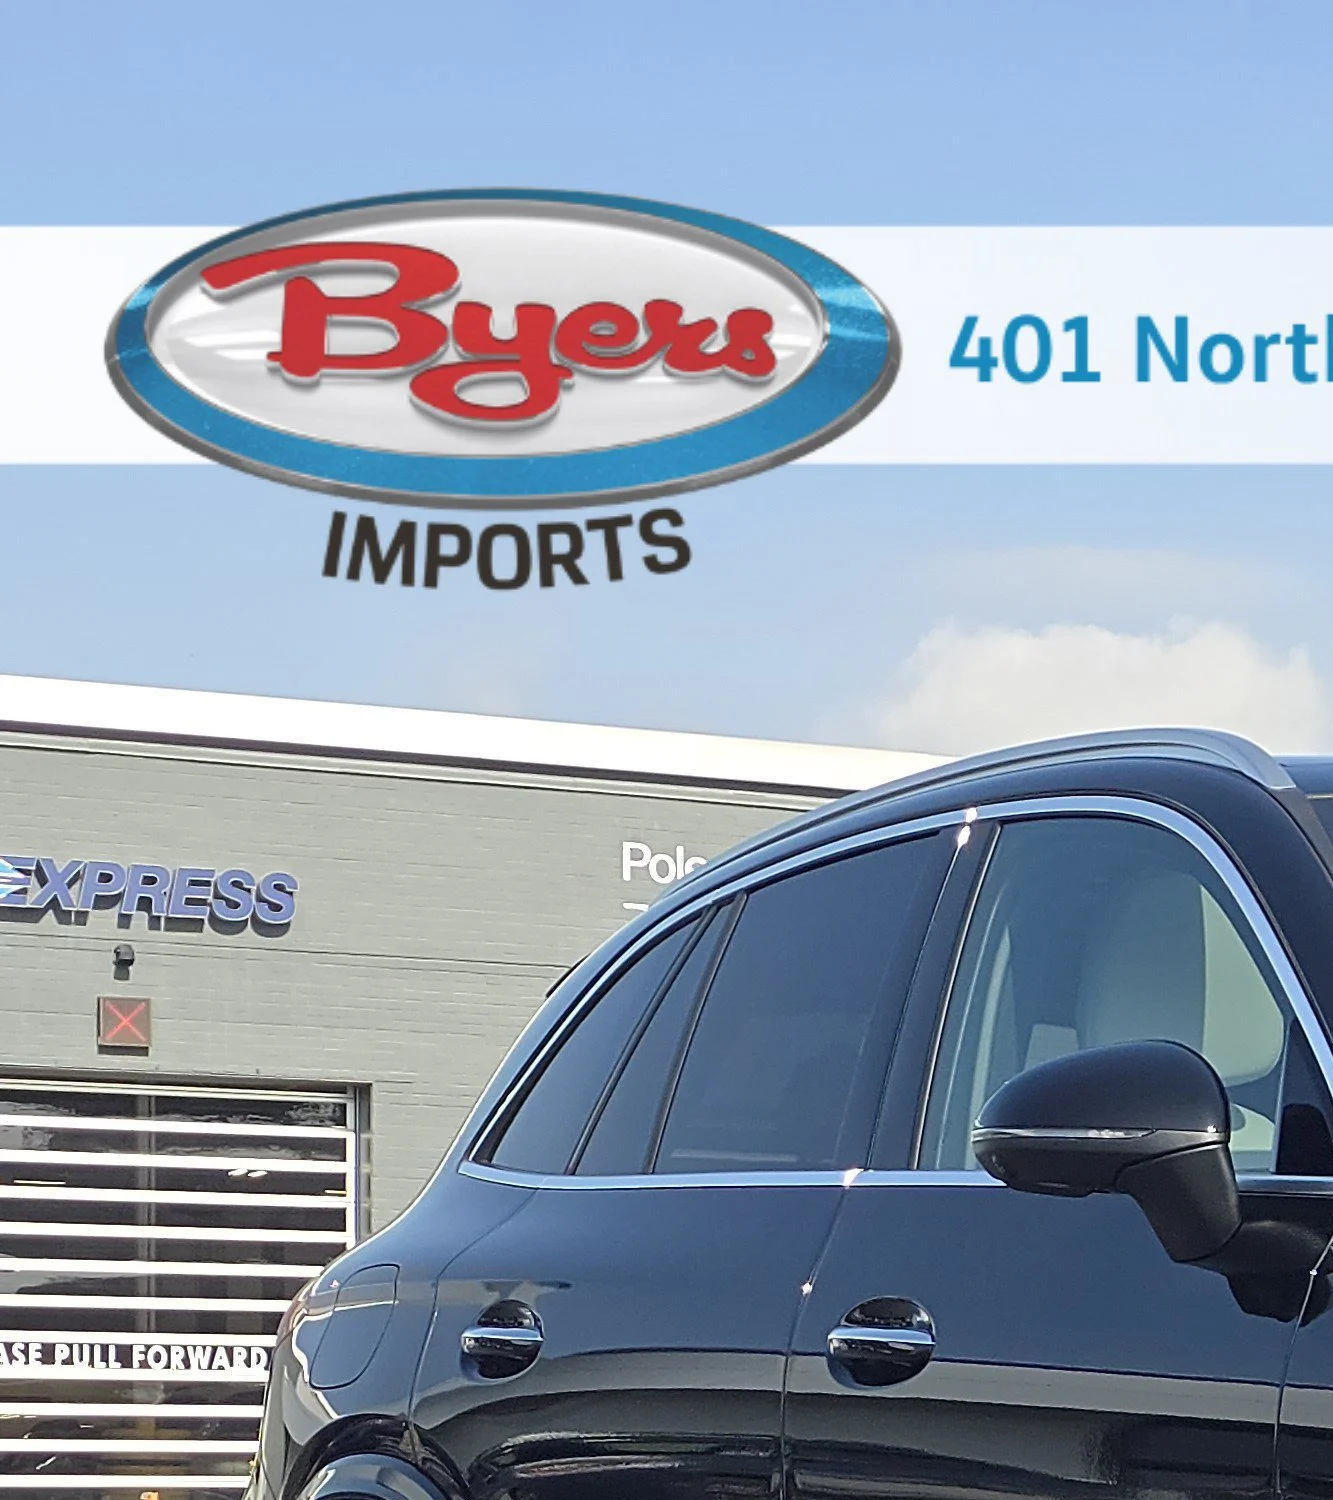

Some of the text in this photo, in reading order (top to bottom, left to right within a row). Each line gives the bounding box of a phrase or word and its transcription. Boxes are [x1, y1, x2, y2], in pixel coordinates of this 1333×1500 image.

[0, 855, 299, 925] EXPRESS
[55, 1343, 122, 1369] PULL
[132, 1345, 269, 1370] FORWARD
